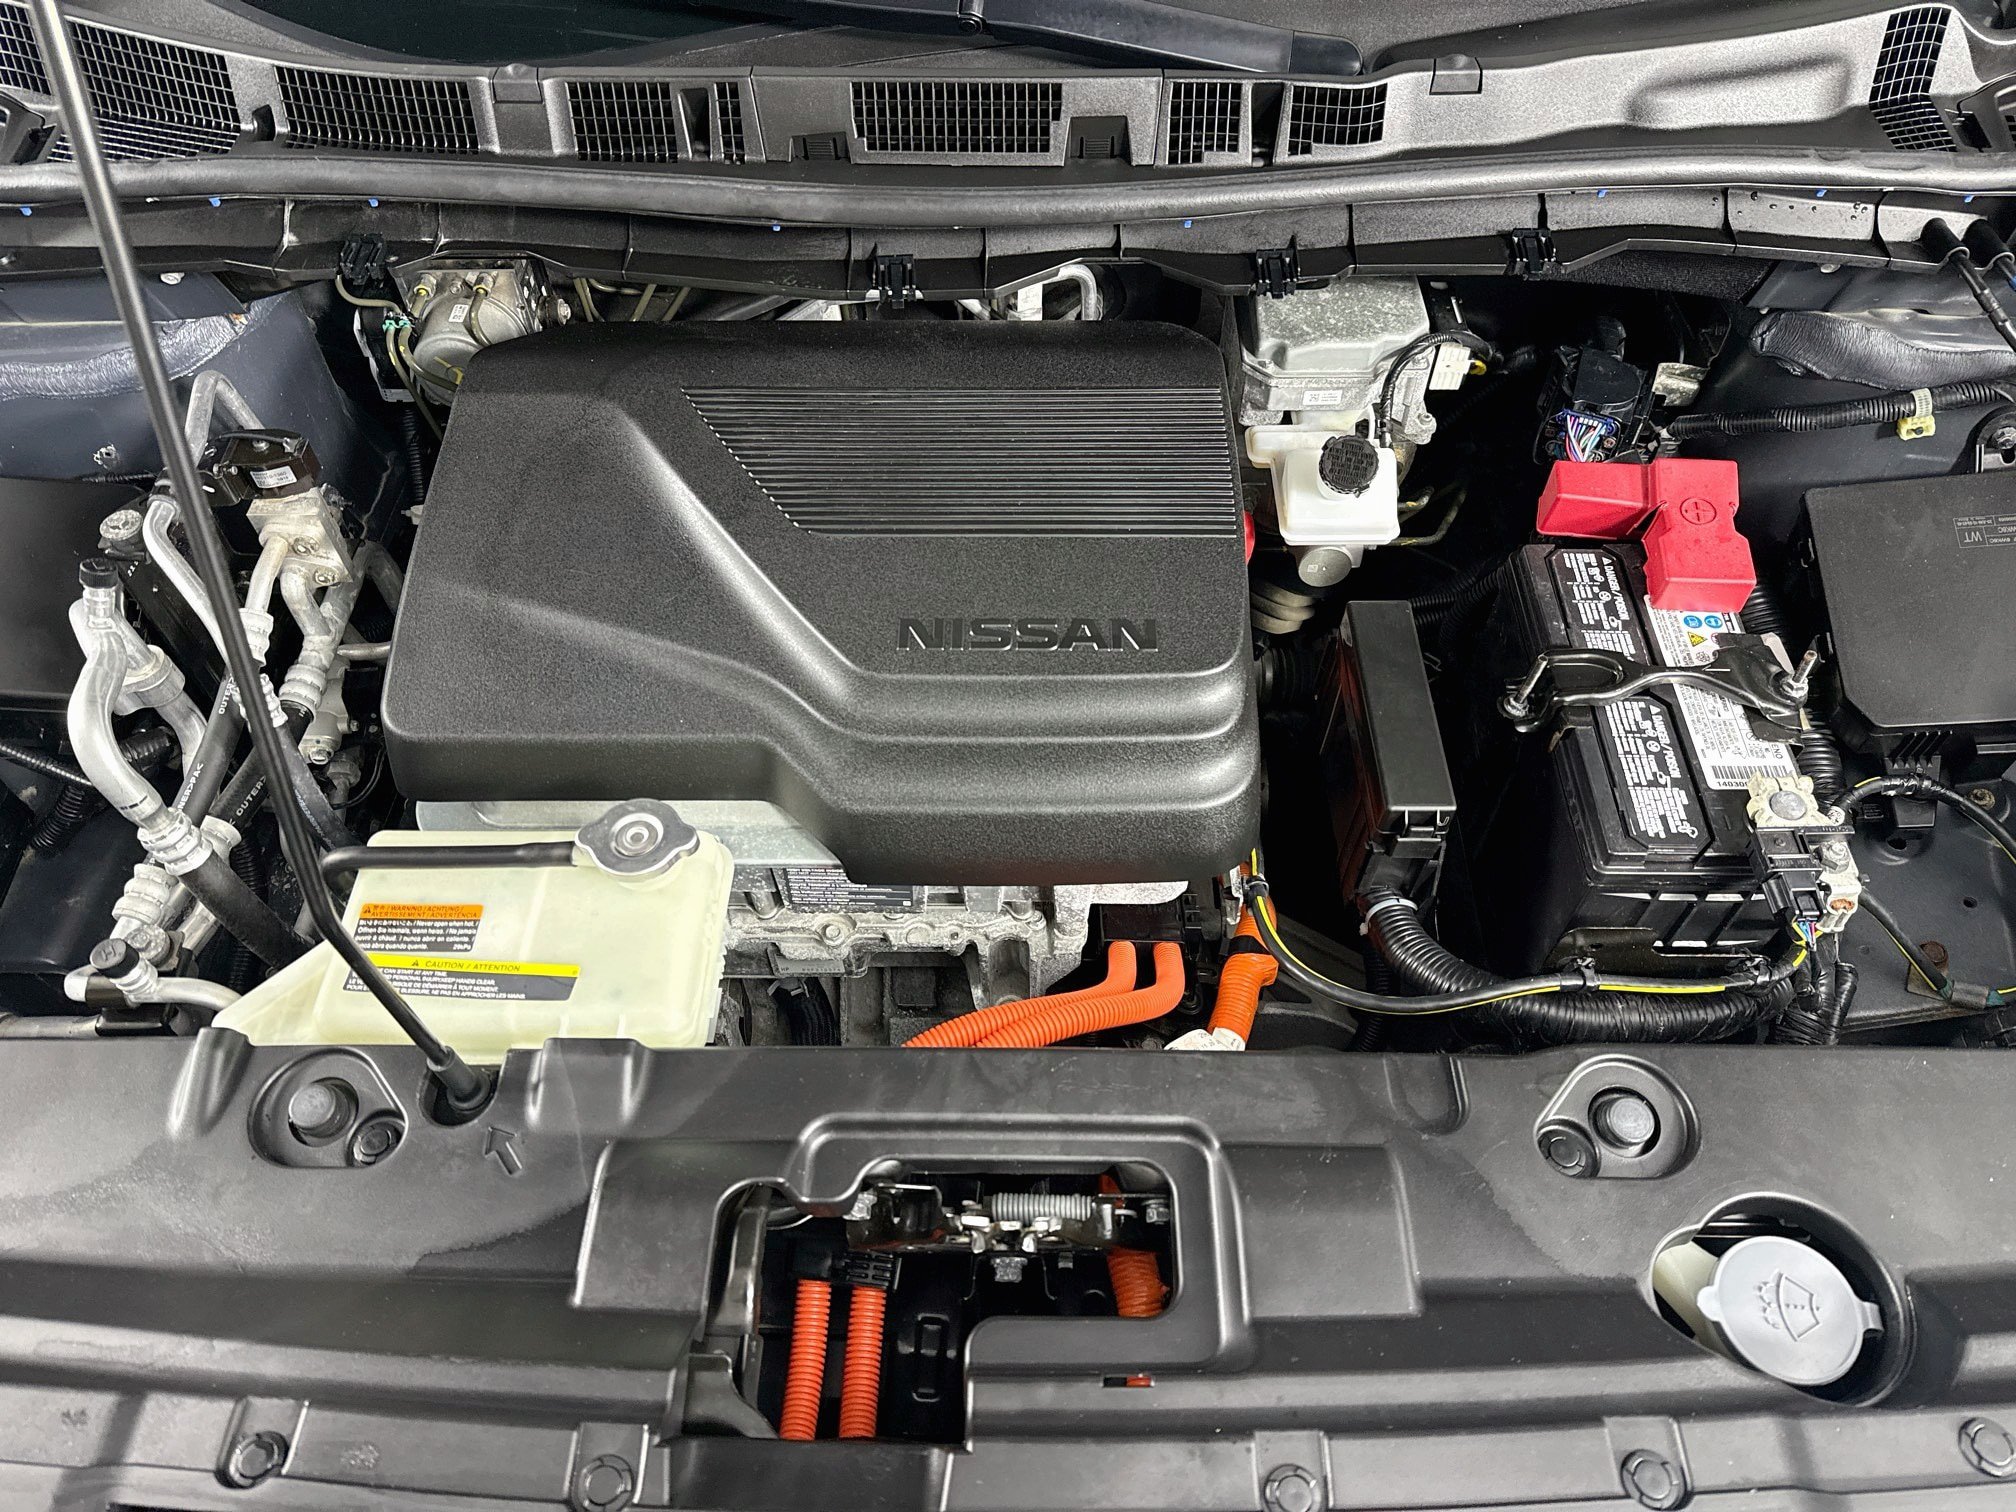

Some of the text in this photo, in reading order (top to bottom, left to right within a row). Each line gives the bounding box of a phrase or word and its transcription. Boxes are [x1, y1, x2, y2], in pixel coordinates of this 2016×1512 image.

[1964, 531, 1983, 542] WT
[897, 617, 1159, 652] NISSAN
[427, 905, 460, 913] ACHTUNG
[425, 960, 464, 969] CAUTION
[473, 963, 521, 972] ATTENTION
